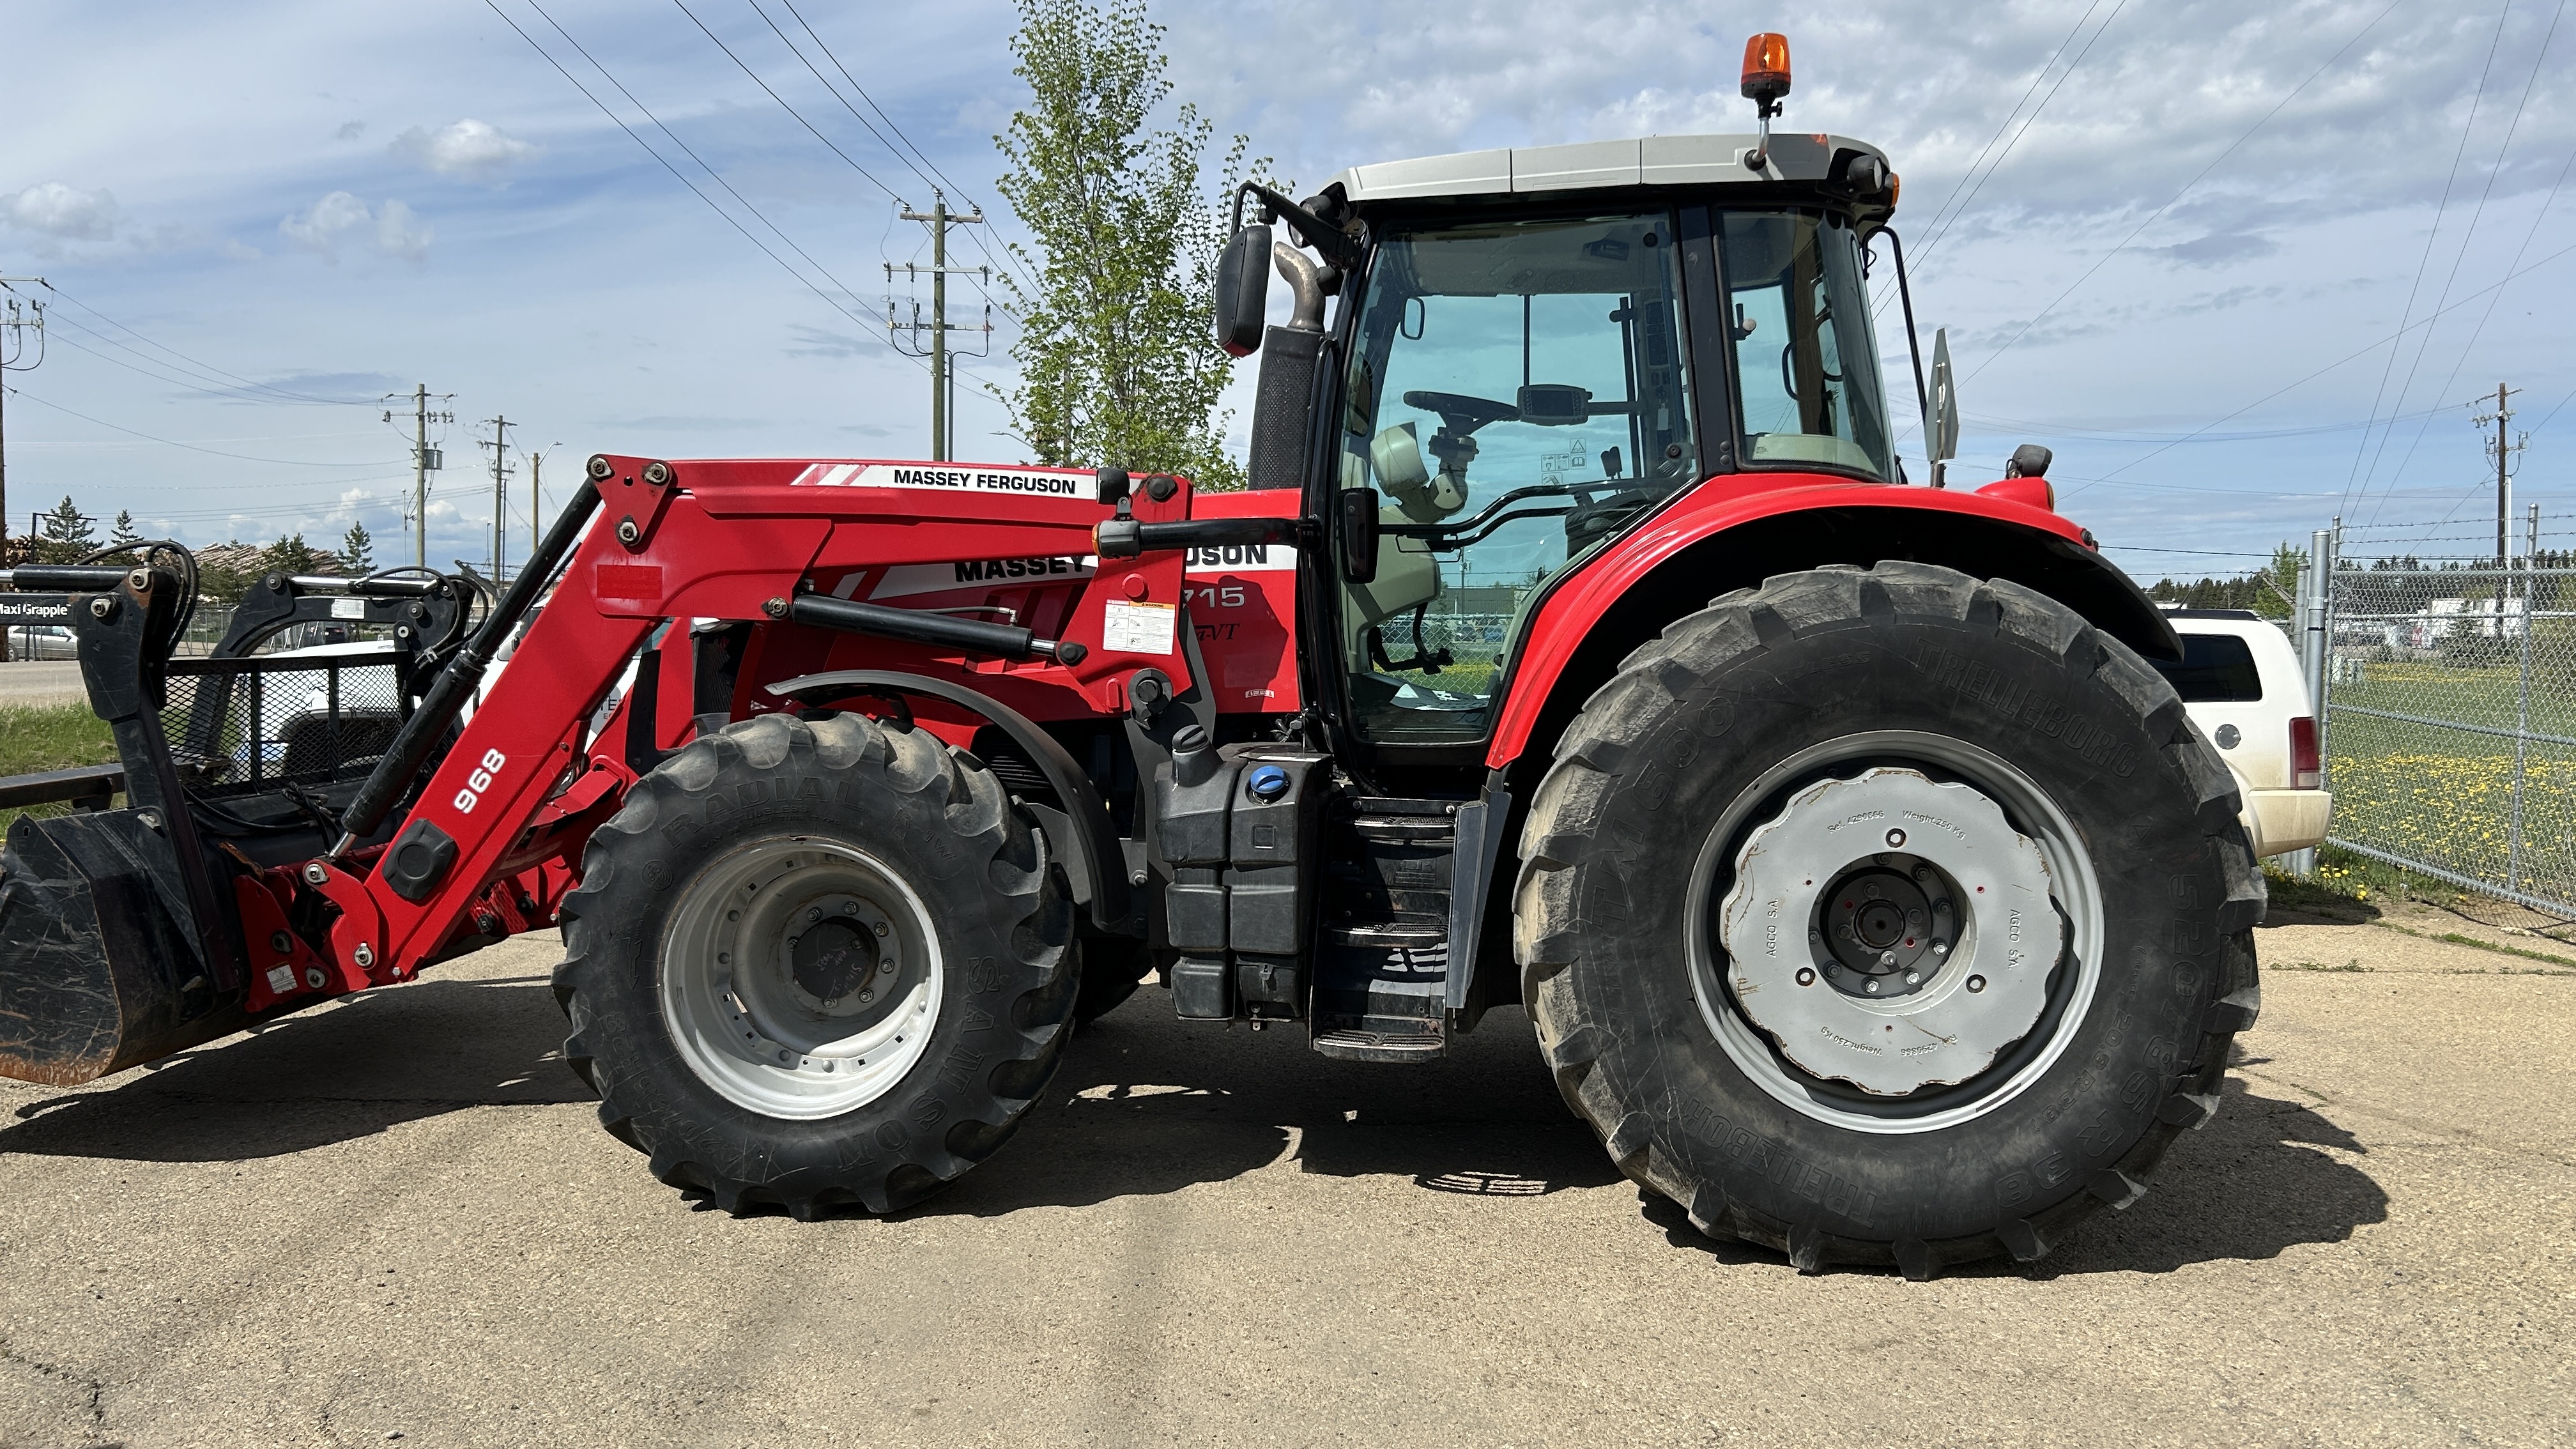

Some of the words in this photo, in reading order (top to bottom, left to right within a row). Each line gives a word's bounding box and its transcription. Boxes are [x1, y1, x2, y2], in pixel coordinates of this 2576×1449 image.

[894, 470, 970, 487] MASSEY
[977, 474, 1076, 494] FERGUSON
[954, 555, 1085, 583] MASSEY
[1186, 544, 1268, 567] USON
[1183, 586, 1245, 608] 715
[1916, 637, 2142, 778] TRELLEBORG
[453, 747, 507, 814] 968
[660, 776, 865, 849] RADIAL
[1766, 925, 1777, 958] AGCO
[2009, 908, 2021, 943] AGCO
[834, 956, 1000, 1173] SAMSON
[1654, 1087, 1878, 1229] TRELLEBORG
